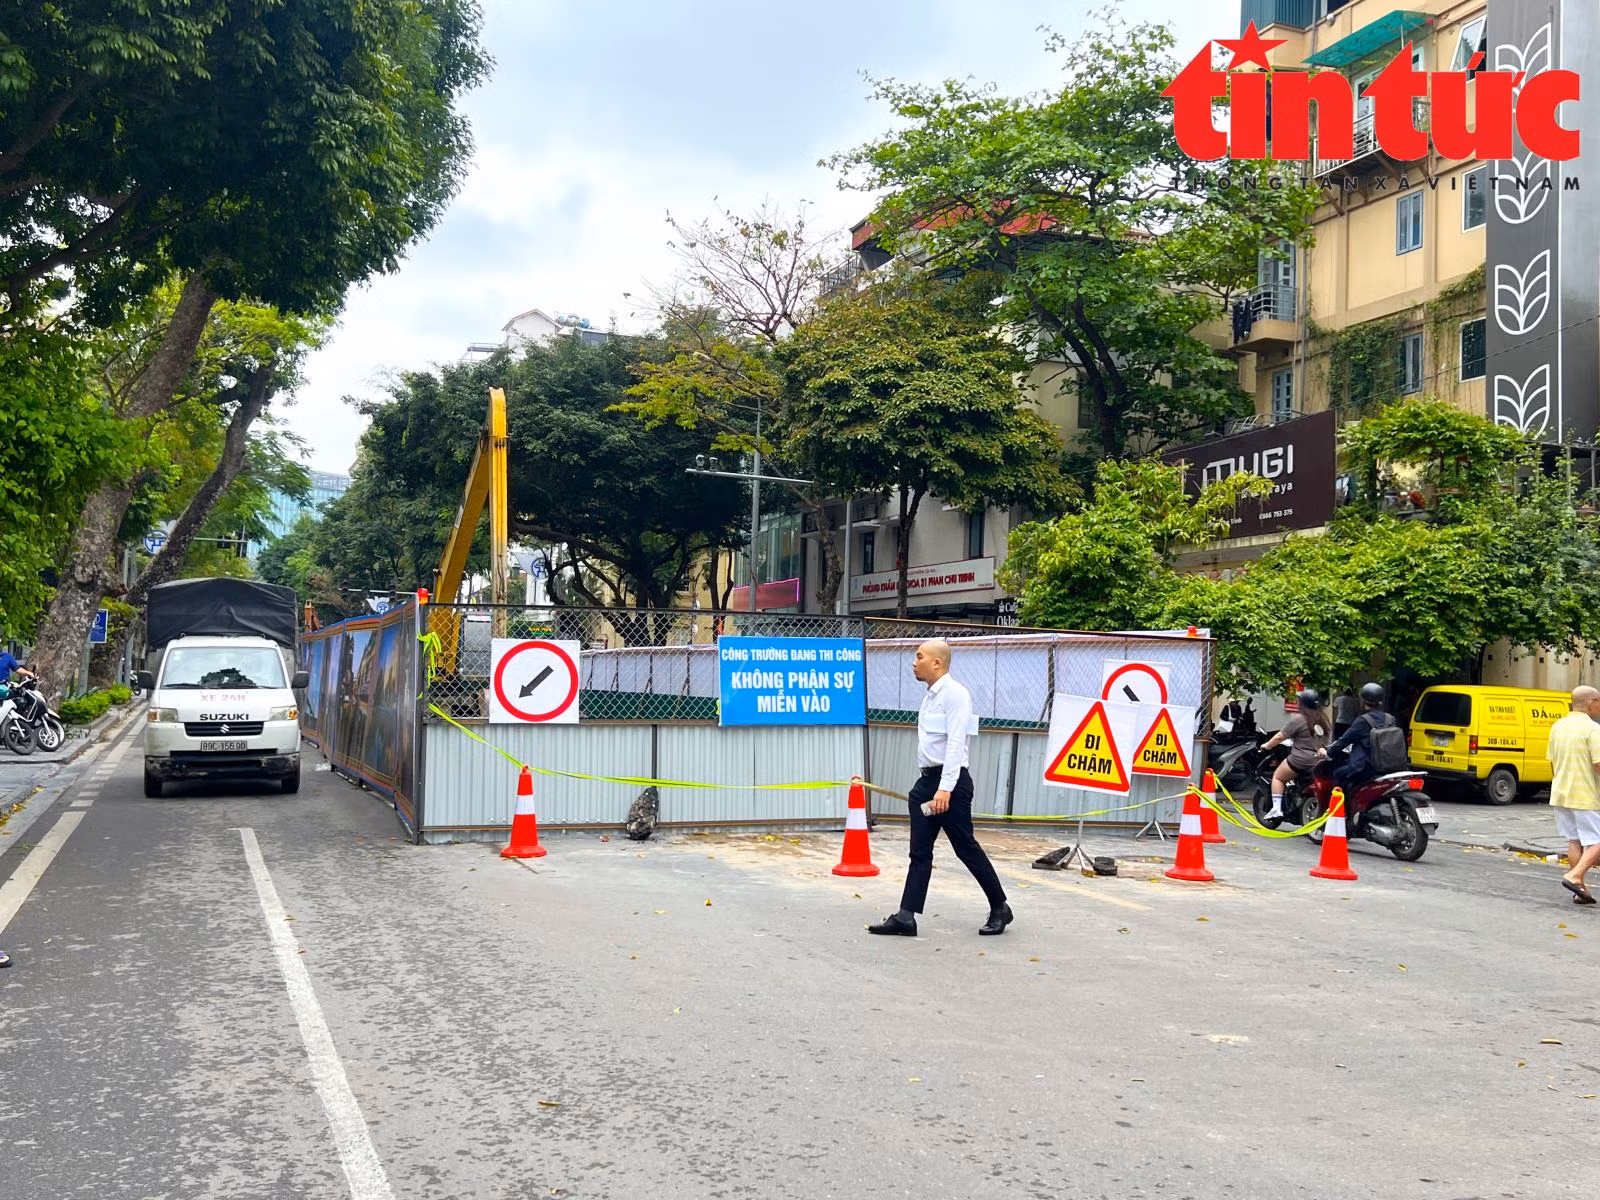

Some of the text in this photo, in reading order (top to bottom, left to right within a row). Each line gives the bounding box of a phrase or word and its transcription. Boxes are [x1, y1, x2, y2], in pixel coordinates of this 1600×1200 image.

[921, 578, 927, 586] 21
[928, 576, 944, 586] PHAN
[721, 646, 861, 661] CÔNG TRƯỜNG ĐANG THI CÔNG
[731, 668, 784, 689] KHÔNG
[833, 671, 855, 693] SỰ
[757, 688, 831, 713] MIỄN VÀO
[199, 713, 249, 721] SUZUKI
[1084, 733, 1101, 751] ĐI
[1155, 733, 1168, 747] ĐI
[1067, 752, 1112, 776] CHẬM
[1143, 748, 1177, 766] CHẬM
